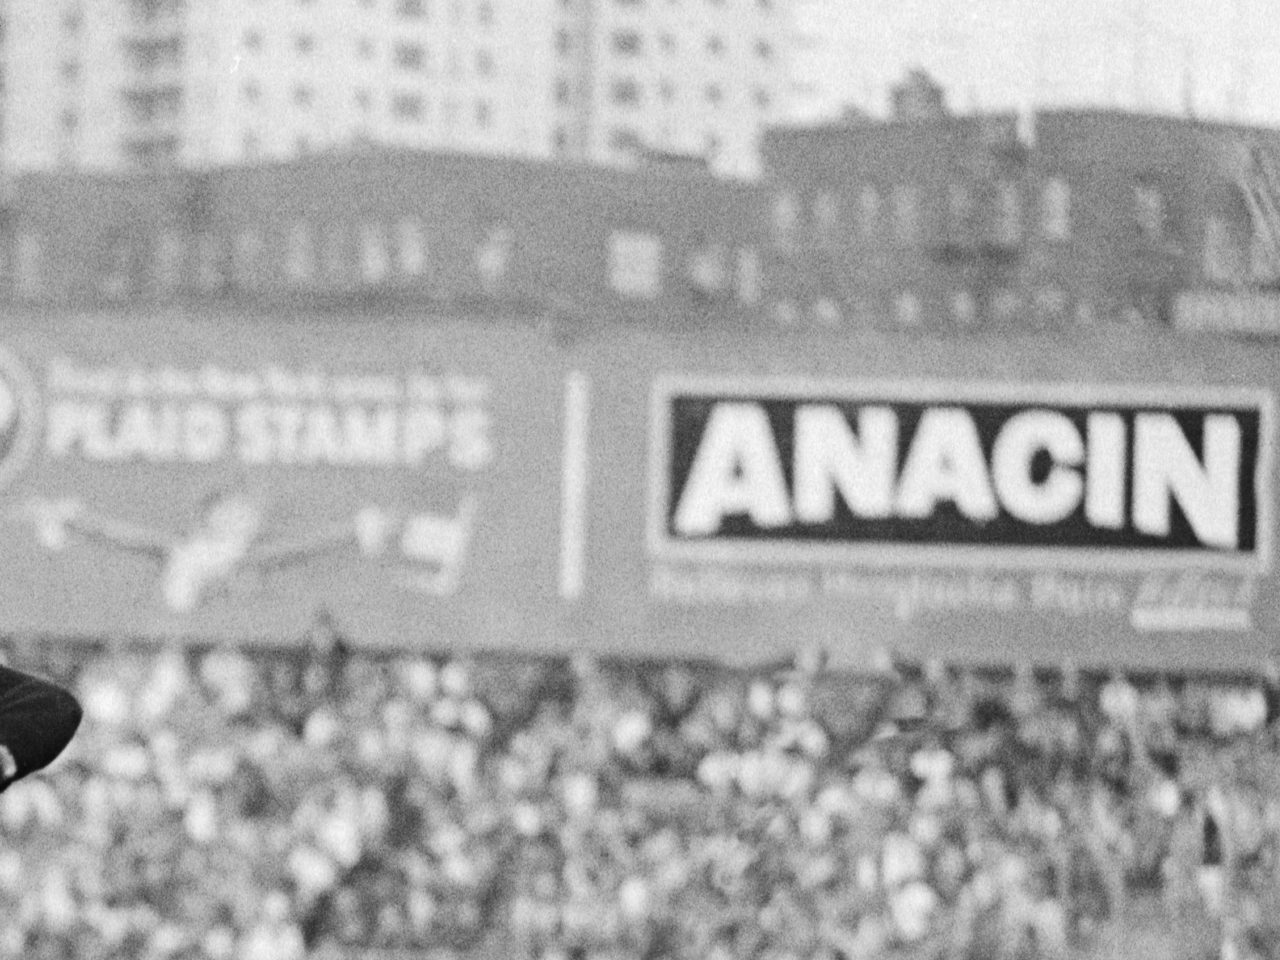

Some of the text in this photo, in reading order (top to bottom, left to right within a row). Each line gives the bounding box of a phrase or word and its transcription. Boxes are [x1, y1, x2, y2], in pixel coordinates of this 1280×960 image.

[46, 402, 492, 470] PLAID STAMPS
[673, 400, 1242, 549] ANACIN
